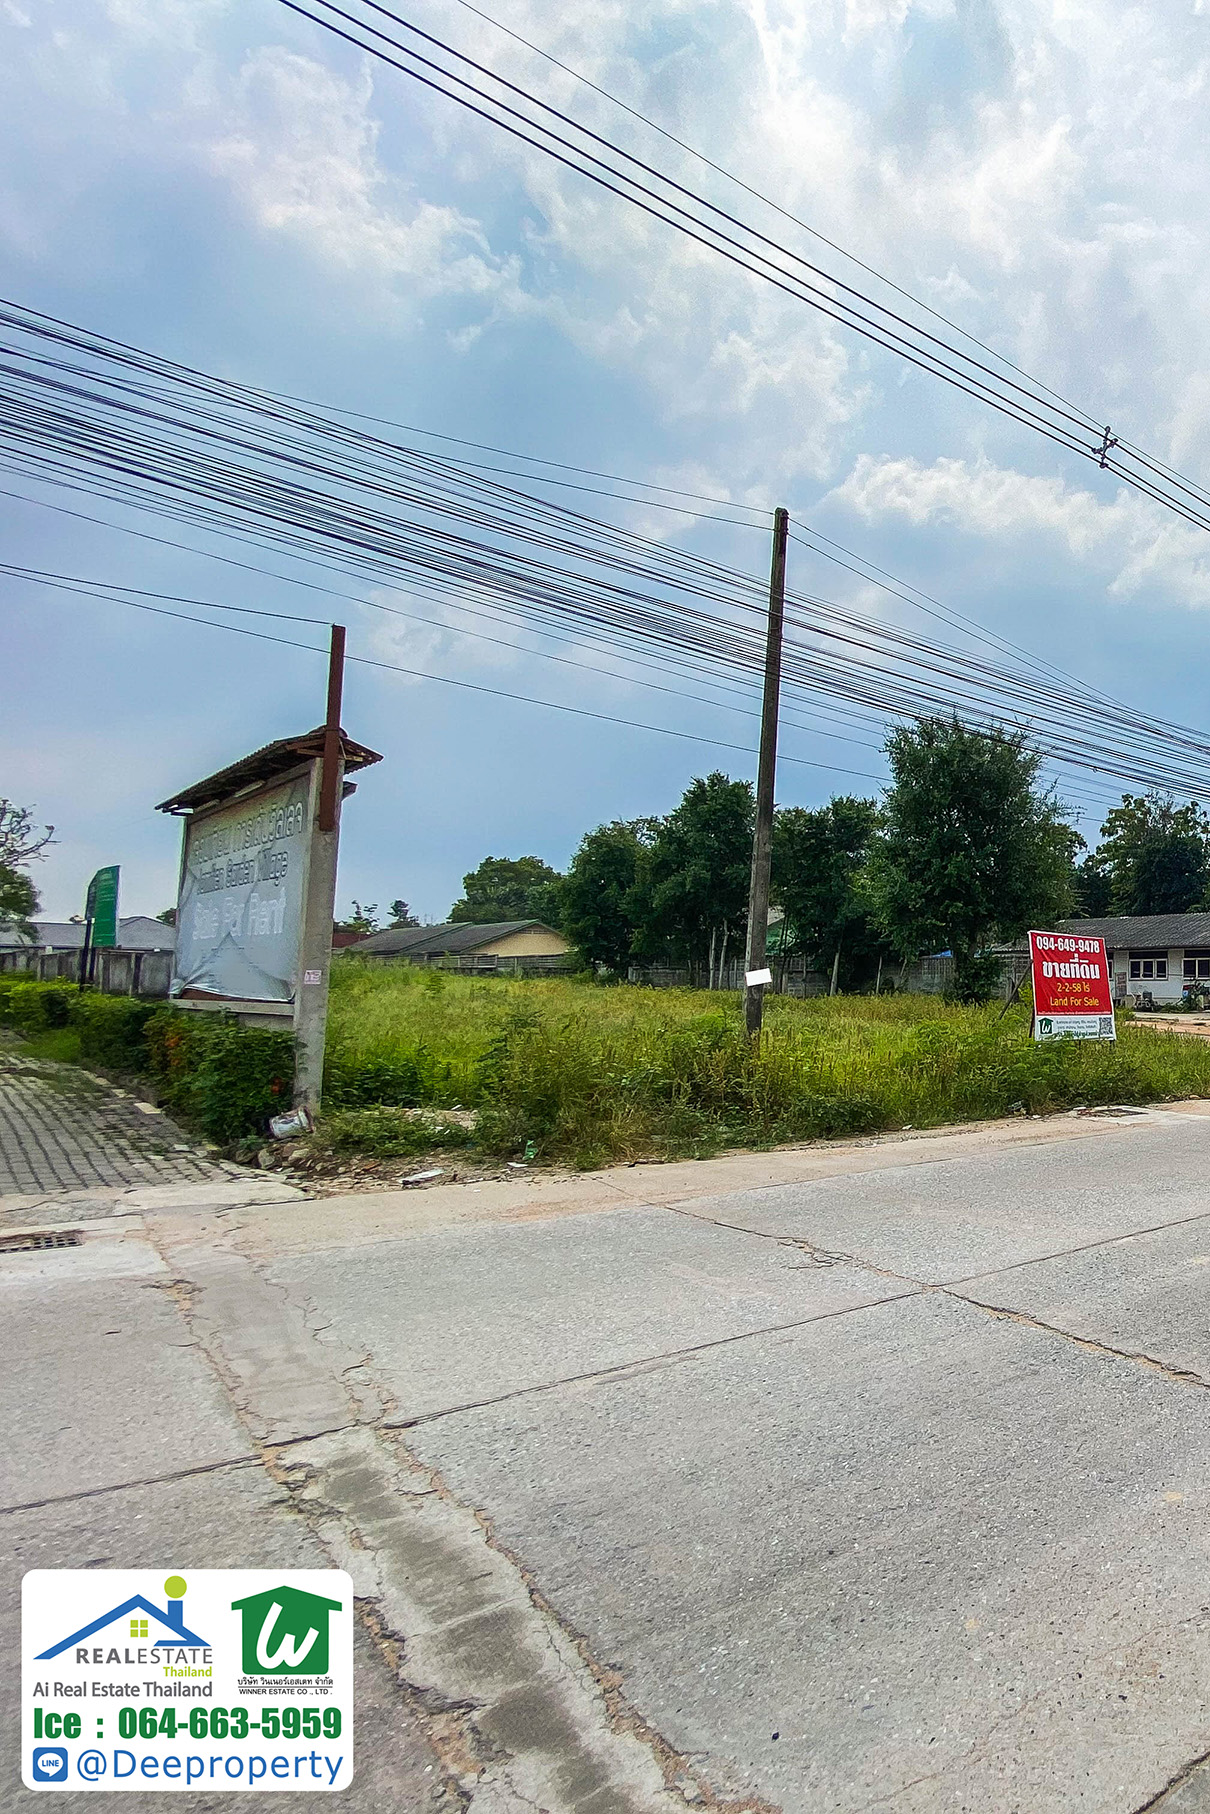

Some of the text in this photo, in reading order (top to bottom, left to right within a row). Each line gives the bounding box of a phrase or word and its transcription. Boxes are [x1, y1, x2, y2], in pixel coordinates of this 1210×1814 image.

[1036, 936, 1100, 953] 094-649-9478
[1042, 953, 1100, 979] ขายที่ดิน
[1057, 982, 1081, 992] 2-2-58
[1050, 996, 1099, 1006] Land For Sale
